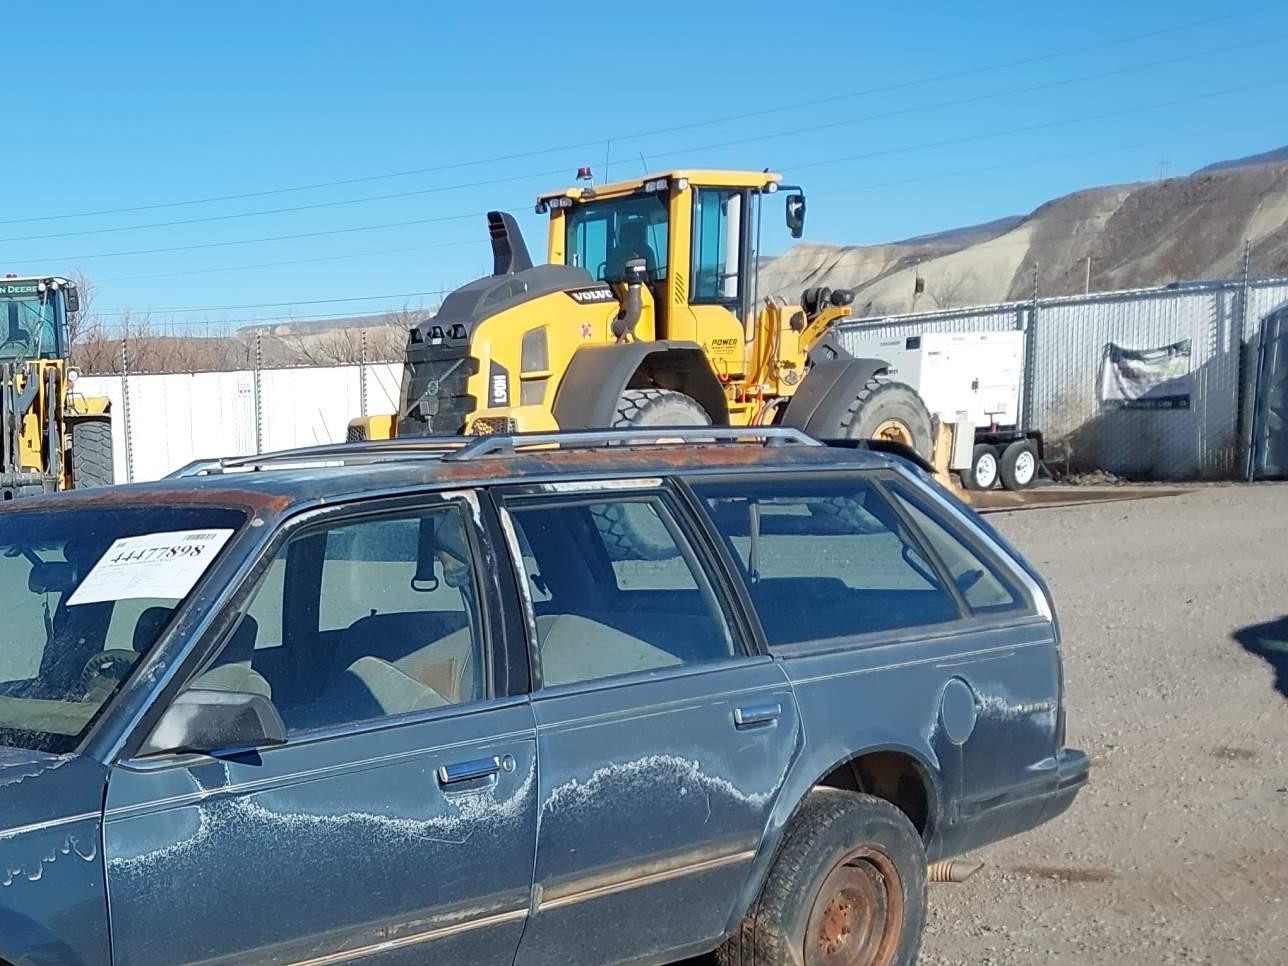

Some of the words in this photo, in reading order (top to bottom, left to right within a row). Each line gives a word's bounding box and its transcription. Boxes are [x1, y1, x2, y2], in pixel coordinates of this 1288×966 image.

[7, 285, 38, 294] DEERE
[712, 338, 738, 346] POWER
[493, 374, 507, 403] L90H
[110, 544, 205, 563] 44477898
